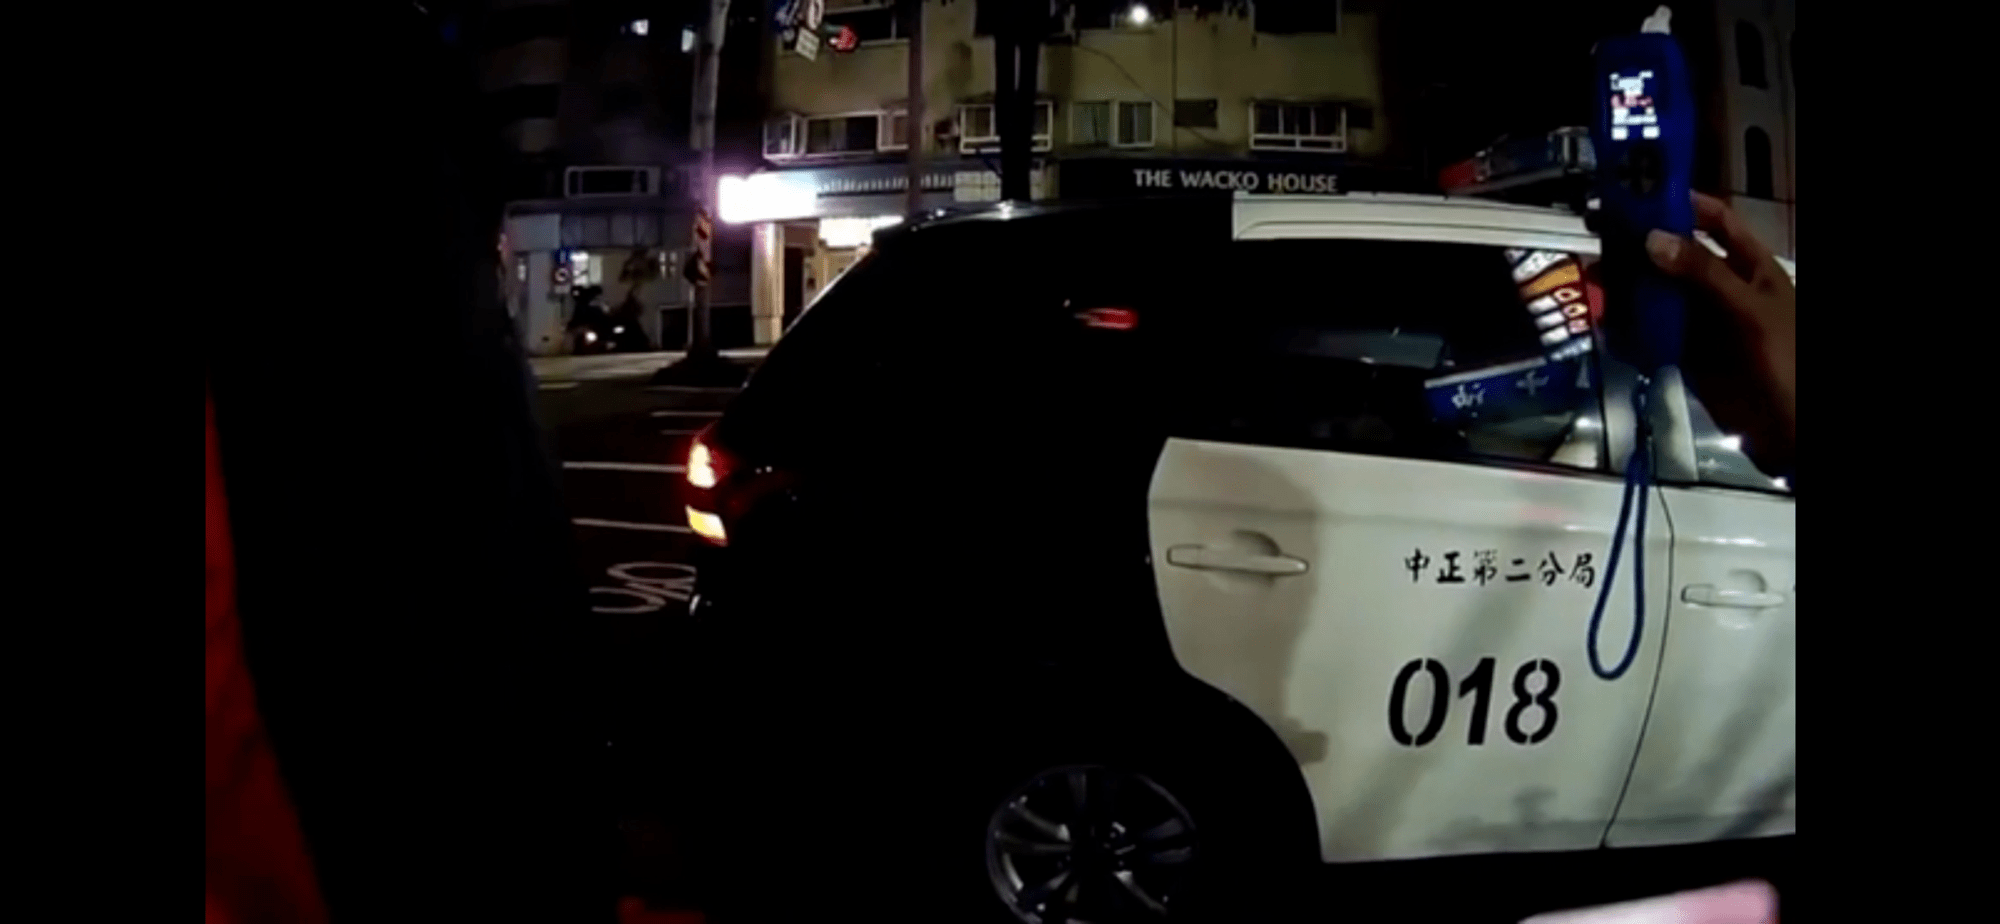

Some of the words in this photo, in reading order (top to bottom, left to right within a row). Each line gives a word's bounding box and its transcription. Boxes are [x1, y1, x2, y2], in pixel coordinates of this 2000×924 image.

[1133, 168, 1173, 188] THE
[1180, 170, 1260, 191] WACKO
[1267, 173, 1339, 193] HOUSE
[1404, 548, 1596, 588] 中正第二分局
[1388, 657, 1560, 747] 018
